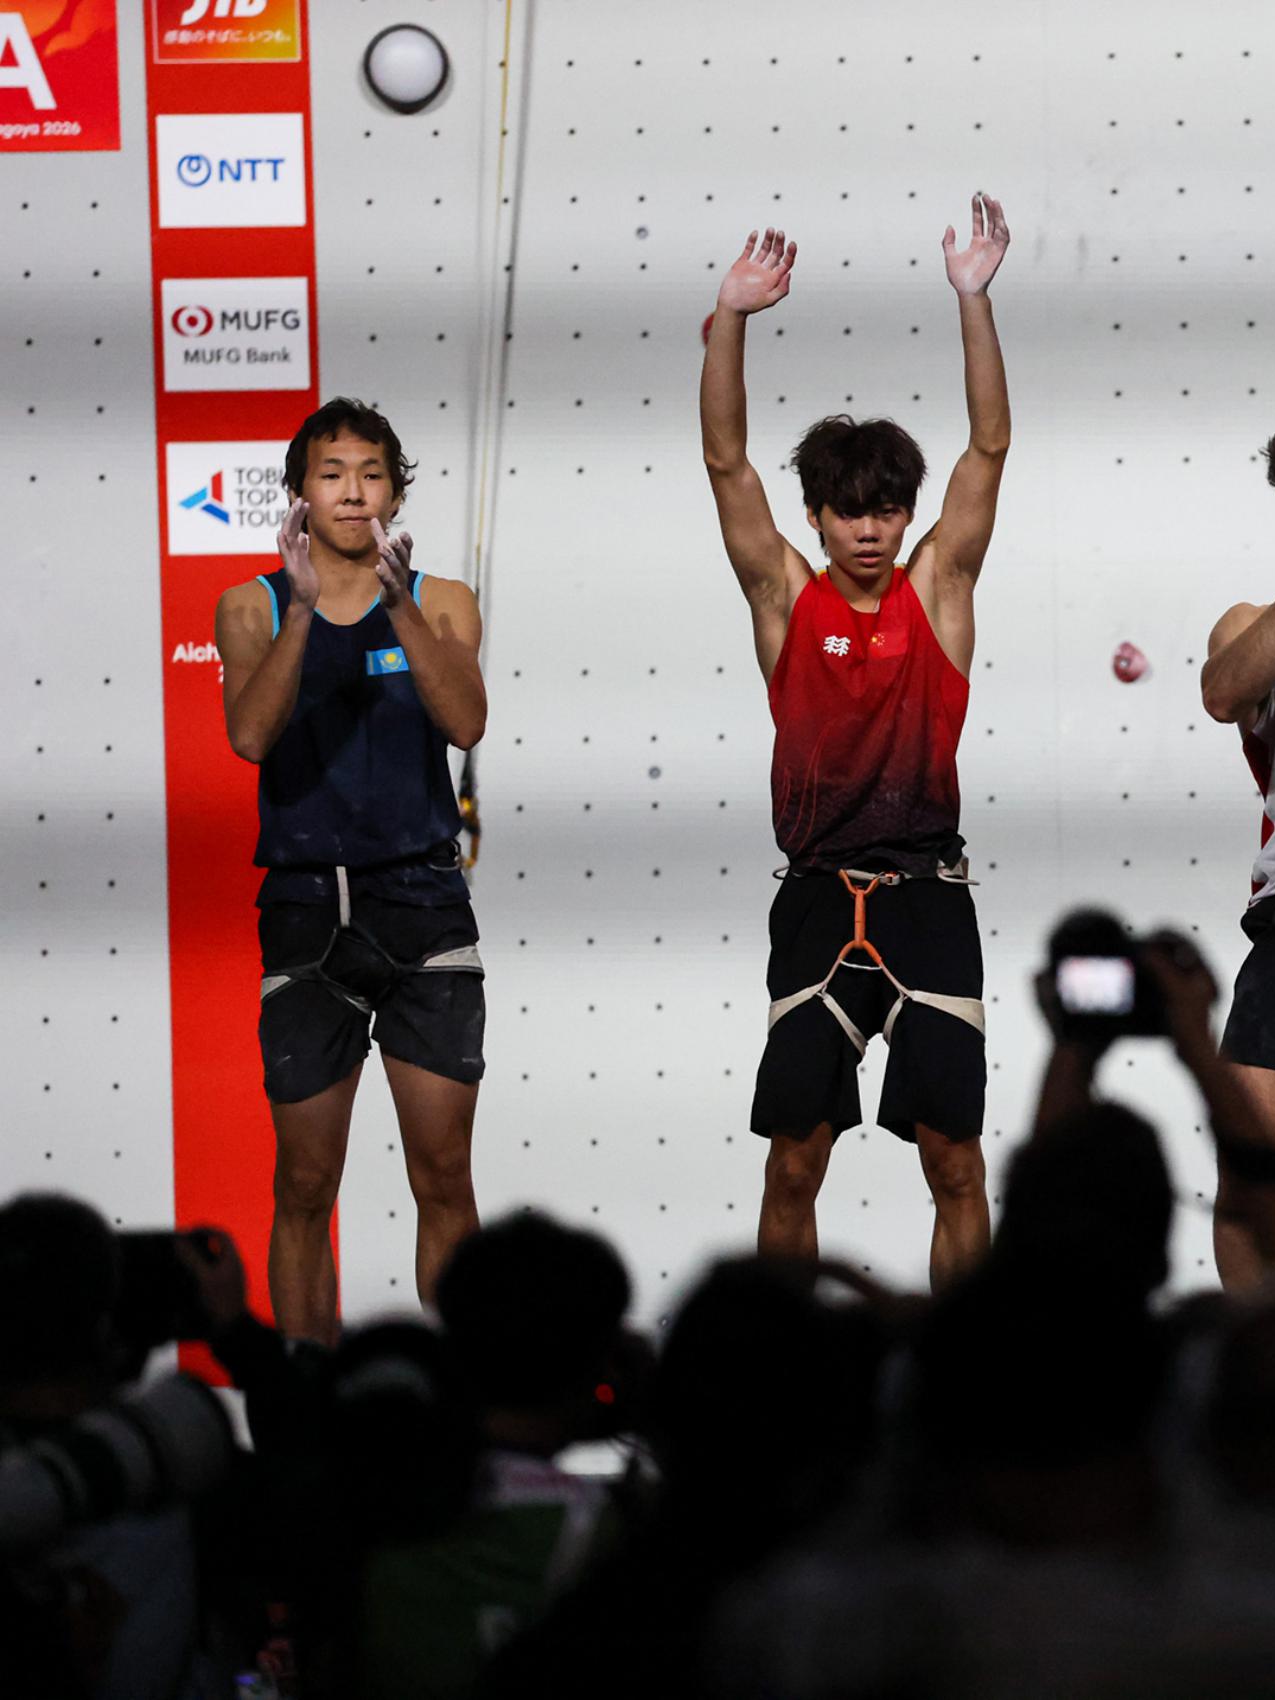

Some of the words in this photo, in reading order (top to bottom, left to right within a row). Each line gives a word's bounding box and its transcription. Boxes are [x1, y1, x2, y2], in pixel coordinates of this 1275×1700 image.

[0, 11, 57, 110] A
[43, 120, 82, 136] 2026
[218, 157, 285, 182] NTT
[220, 309, 301, 331] MUFG
[183, 349, 241, 365] MUFG
[246, 348, 292, 364] Bank
[235, 488, 278, 507] TOP
